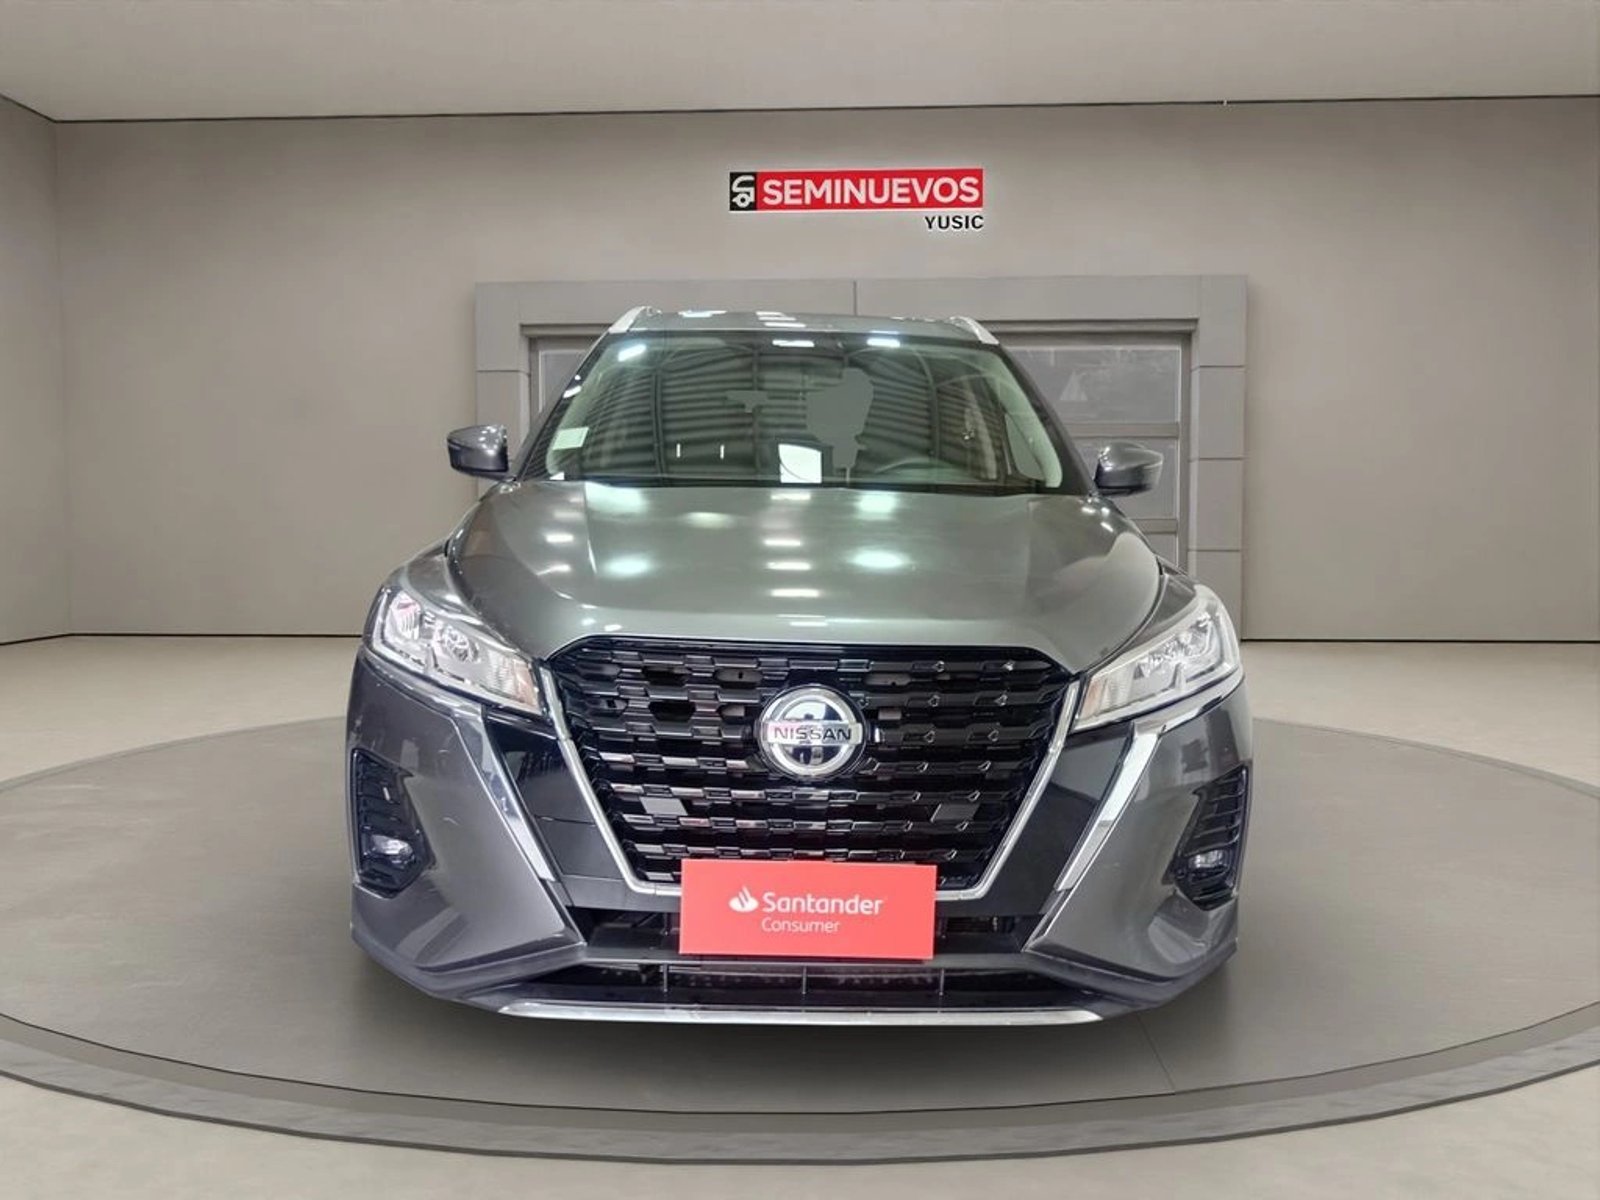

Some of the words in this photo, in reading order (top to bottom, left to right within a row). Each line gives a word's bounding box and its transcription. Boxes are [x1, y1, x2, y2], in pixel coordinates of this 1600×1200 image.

[763, 176, 980, 205] SEMINUEVOS
[925, 215, 984, 230] YUSIC
[774, 727, 852, 741] NISSAN
[762, 892, 883, 915] Santander
[761, 917, 841, 932] Consumer
